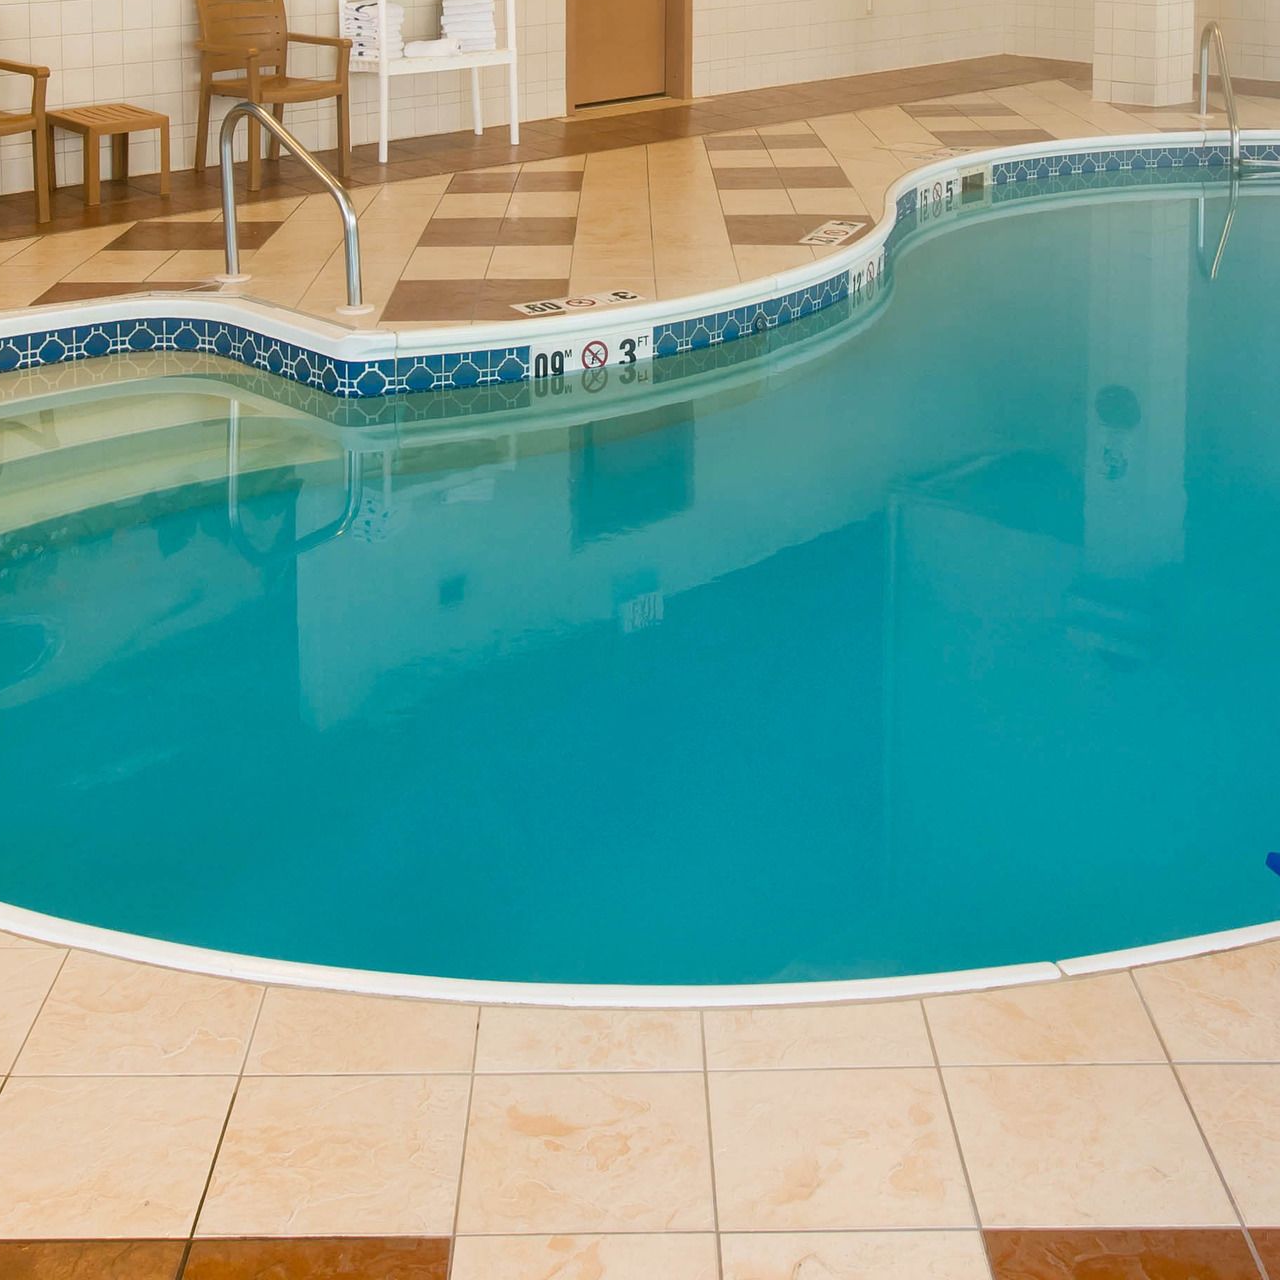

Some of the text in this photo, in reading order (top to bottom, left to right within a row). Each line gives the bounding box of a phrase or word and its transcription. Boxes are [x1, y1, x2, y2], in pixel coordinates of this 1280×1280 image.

[564, 348, 573, 358] M
[618, 335, 649, 365] 3 FT
